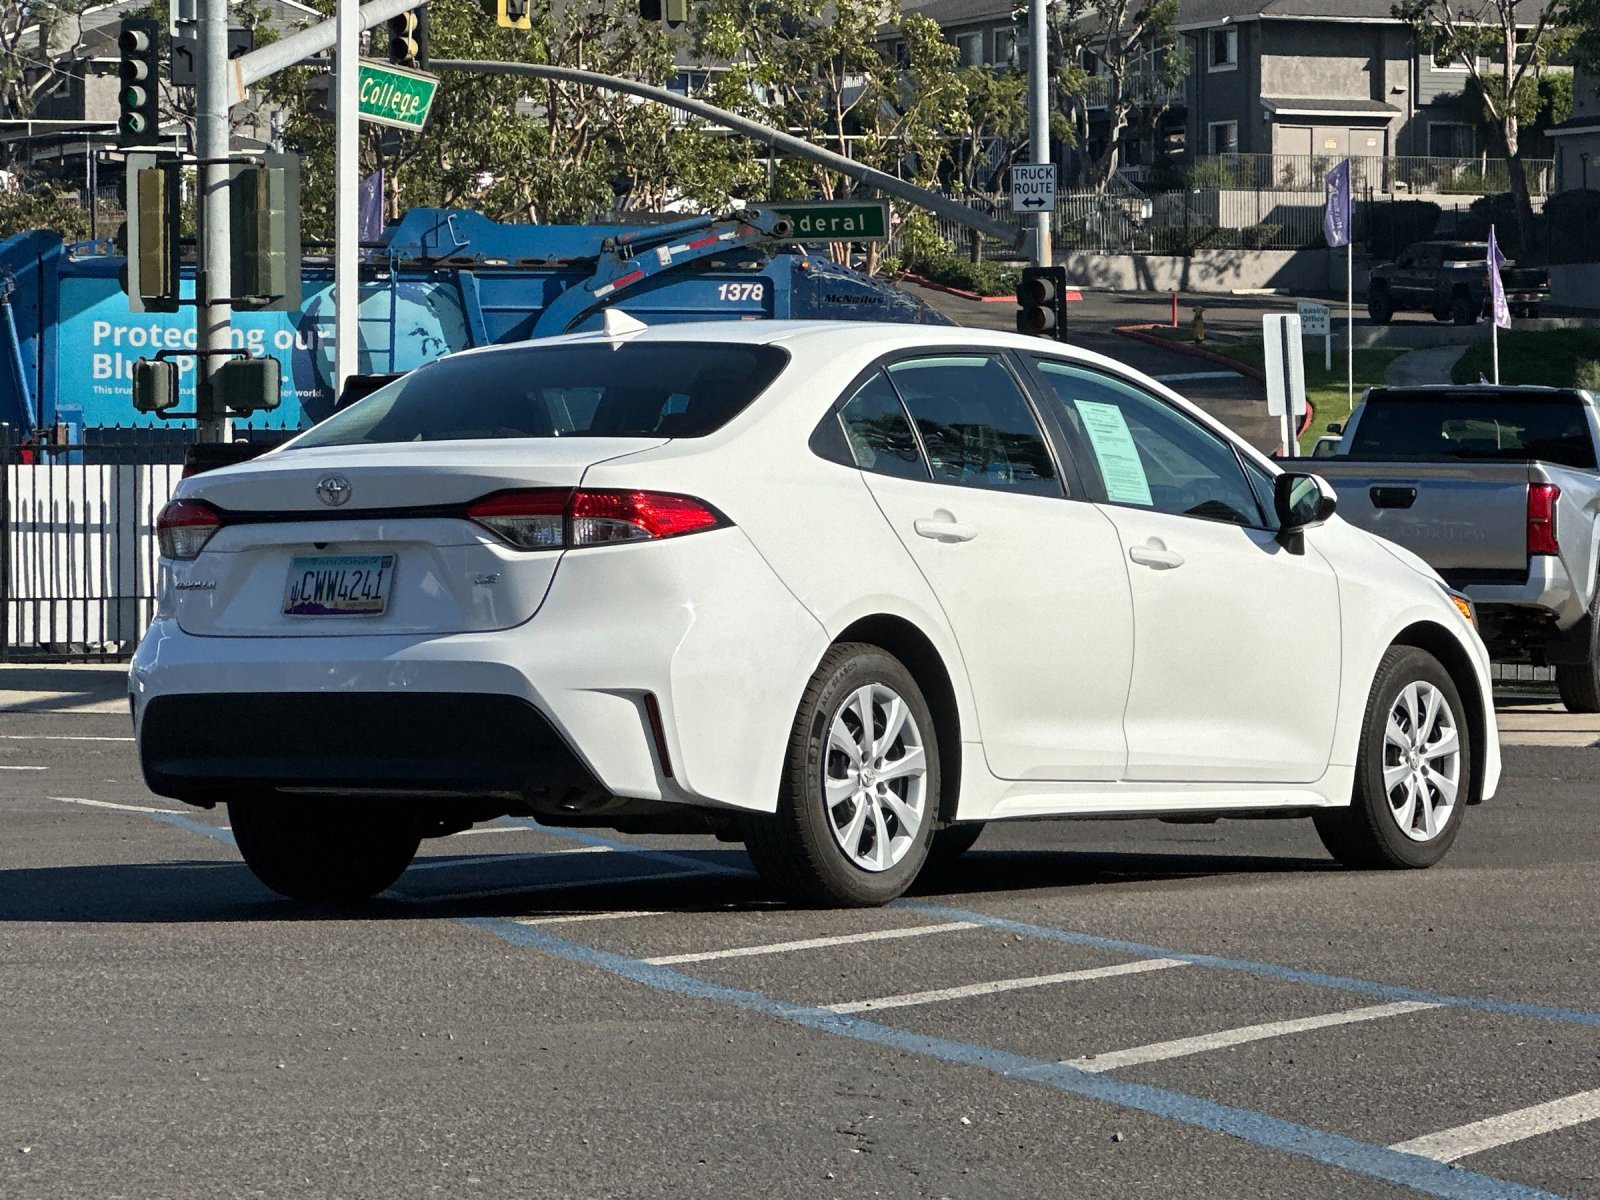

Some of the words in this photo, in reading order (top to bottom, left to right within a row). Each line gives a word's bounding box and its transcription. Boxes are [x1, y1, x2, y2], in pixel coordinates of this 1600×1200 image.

[360, 77, 420, 119] College
[1014, 168, 1053, 180] TRUCK
[1014, 182, 1053, 194] ROUTE
[791, 213, 864, 231] deral
[718, 283, 763, 300] 1378
[824, 294, 883, 305] McNeilus
[1300, 306, 1328, 315] Leasing
[93, 321, 264, 357] Protecng
[274, 329, 331, 350] our
[93, 386, 113, 394] This
[296, 389, 324, 397] world.
[300, 569, 384, 602] CWW4241
